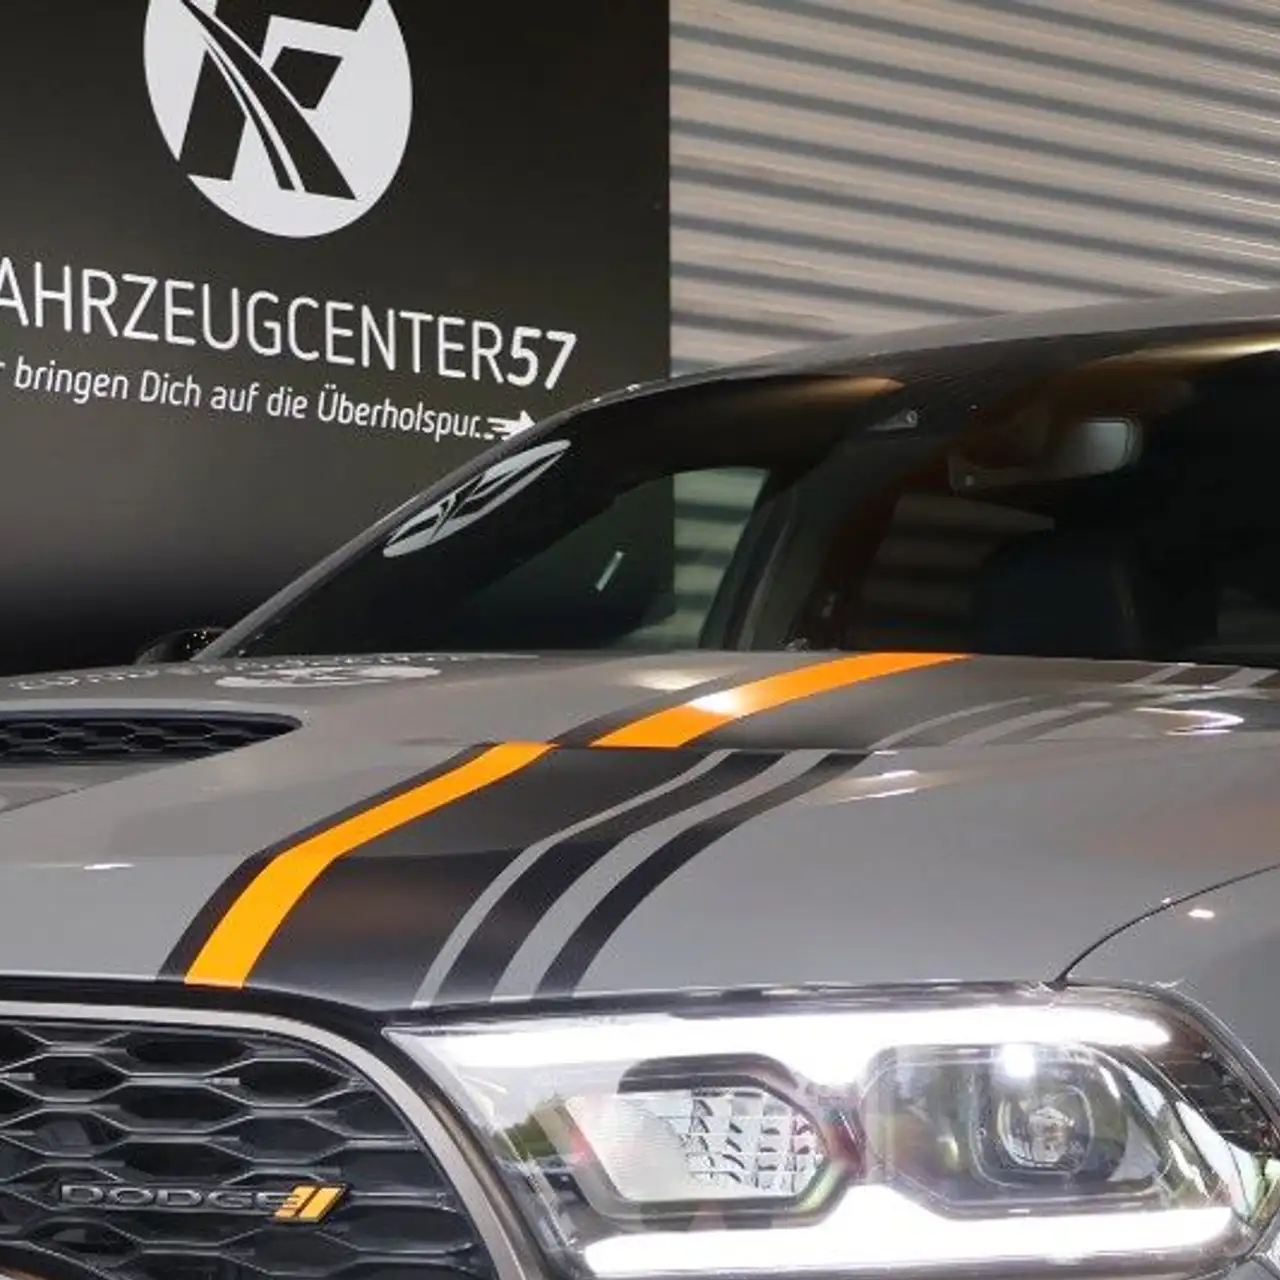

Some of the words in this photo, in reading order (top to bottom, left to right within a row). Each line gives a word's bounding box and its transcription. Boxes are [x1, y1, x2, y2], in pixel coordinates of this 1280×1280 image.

[14, 356, 129, 404] bringen
[139, 369, 202, 408] Dich
[210, 382, 260, 413] auf
[266, 387, 309, 419] die
[61, 1184, 302, 1210] DODGE
